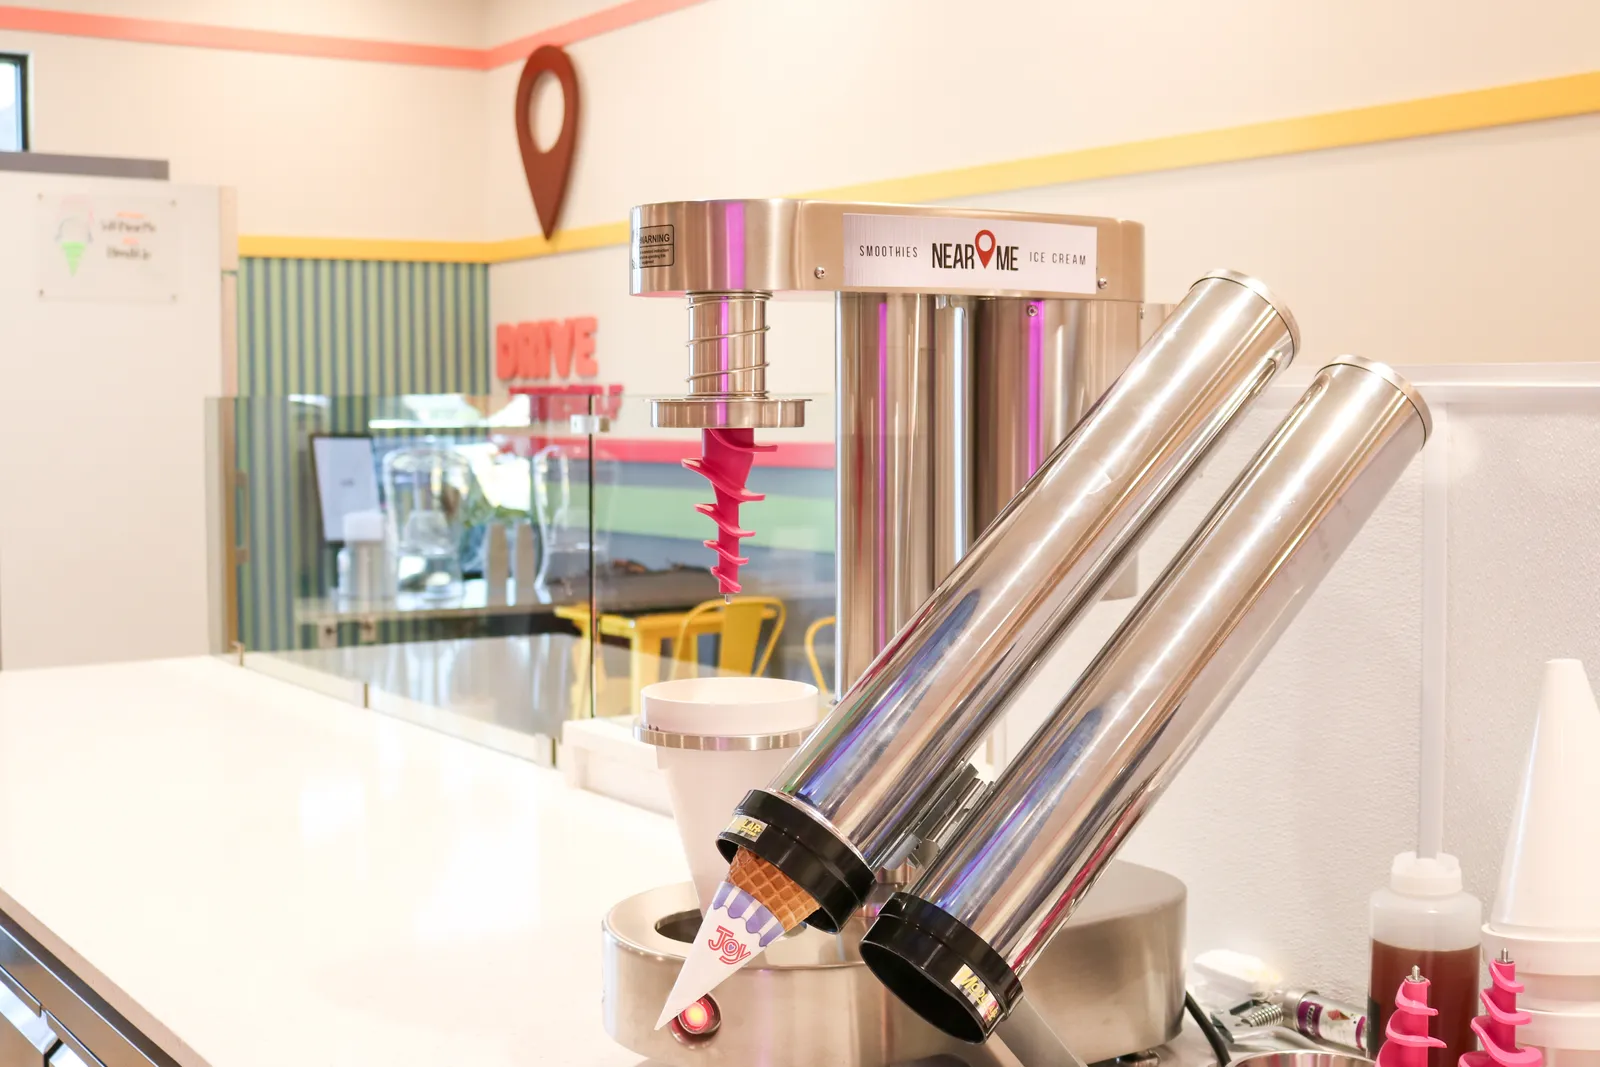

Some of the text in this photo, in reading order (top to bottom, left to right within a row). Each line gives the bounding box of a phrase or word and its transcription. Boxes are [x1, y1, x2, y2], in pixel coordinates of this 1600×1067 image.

[859, 245, 919, 258] SMOOTHIES
[932, 242, 1019, 271] NEAR ME
[1029, 251, 1087, 266] ICE CREAM
[496, 316, 598, 380] DRIVE
